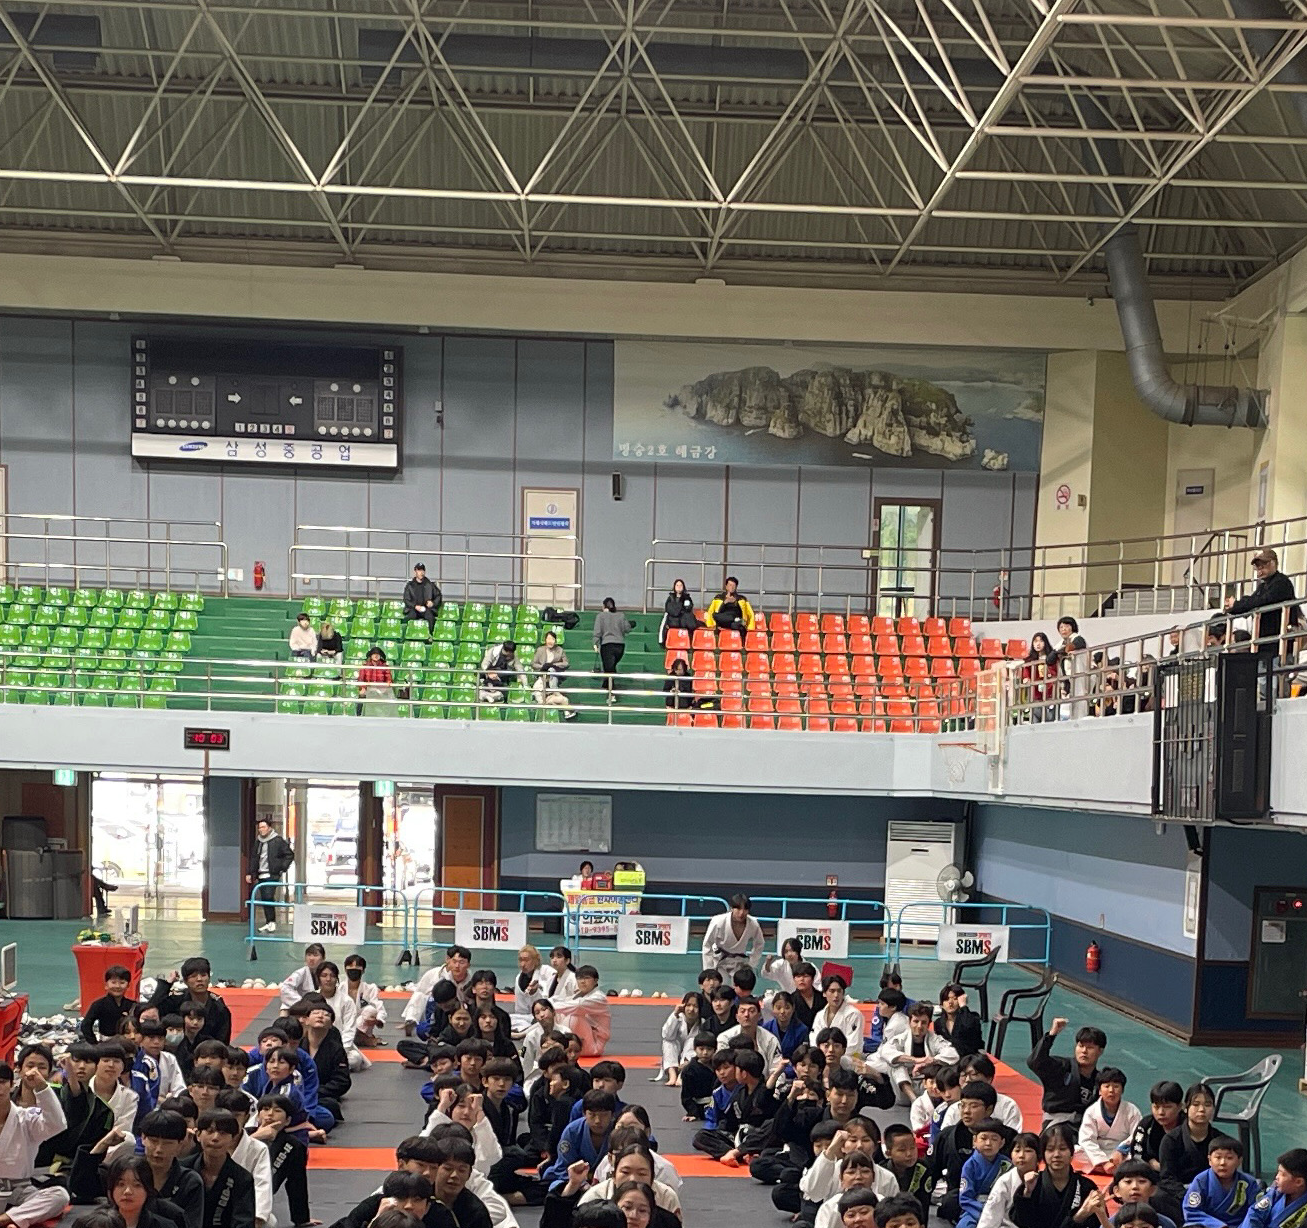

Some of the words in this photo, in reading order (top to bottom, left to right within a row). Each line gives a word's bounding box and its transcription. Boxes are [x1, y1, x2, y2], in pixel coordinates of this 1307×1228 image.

[226, 441, 350, 461] 삼성중공업
[311, 920, 347, 936] SBMS
[473, 925, 509, 942] SBMS
[636, 930, 671, 946] SBMS
[796, 934, 831, 950] SBMS
[956, 939, 991, 956] SBMS
